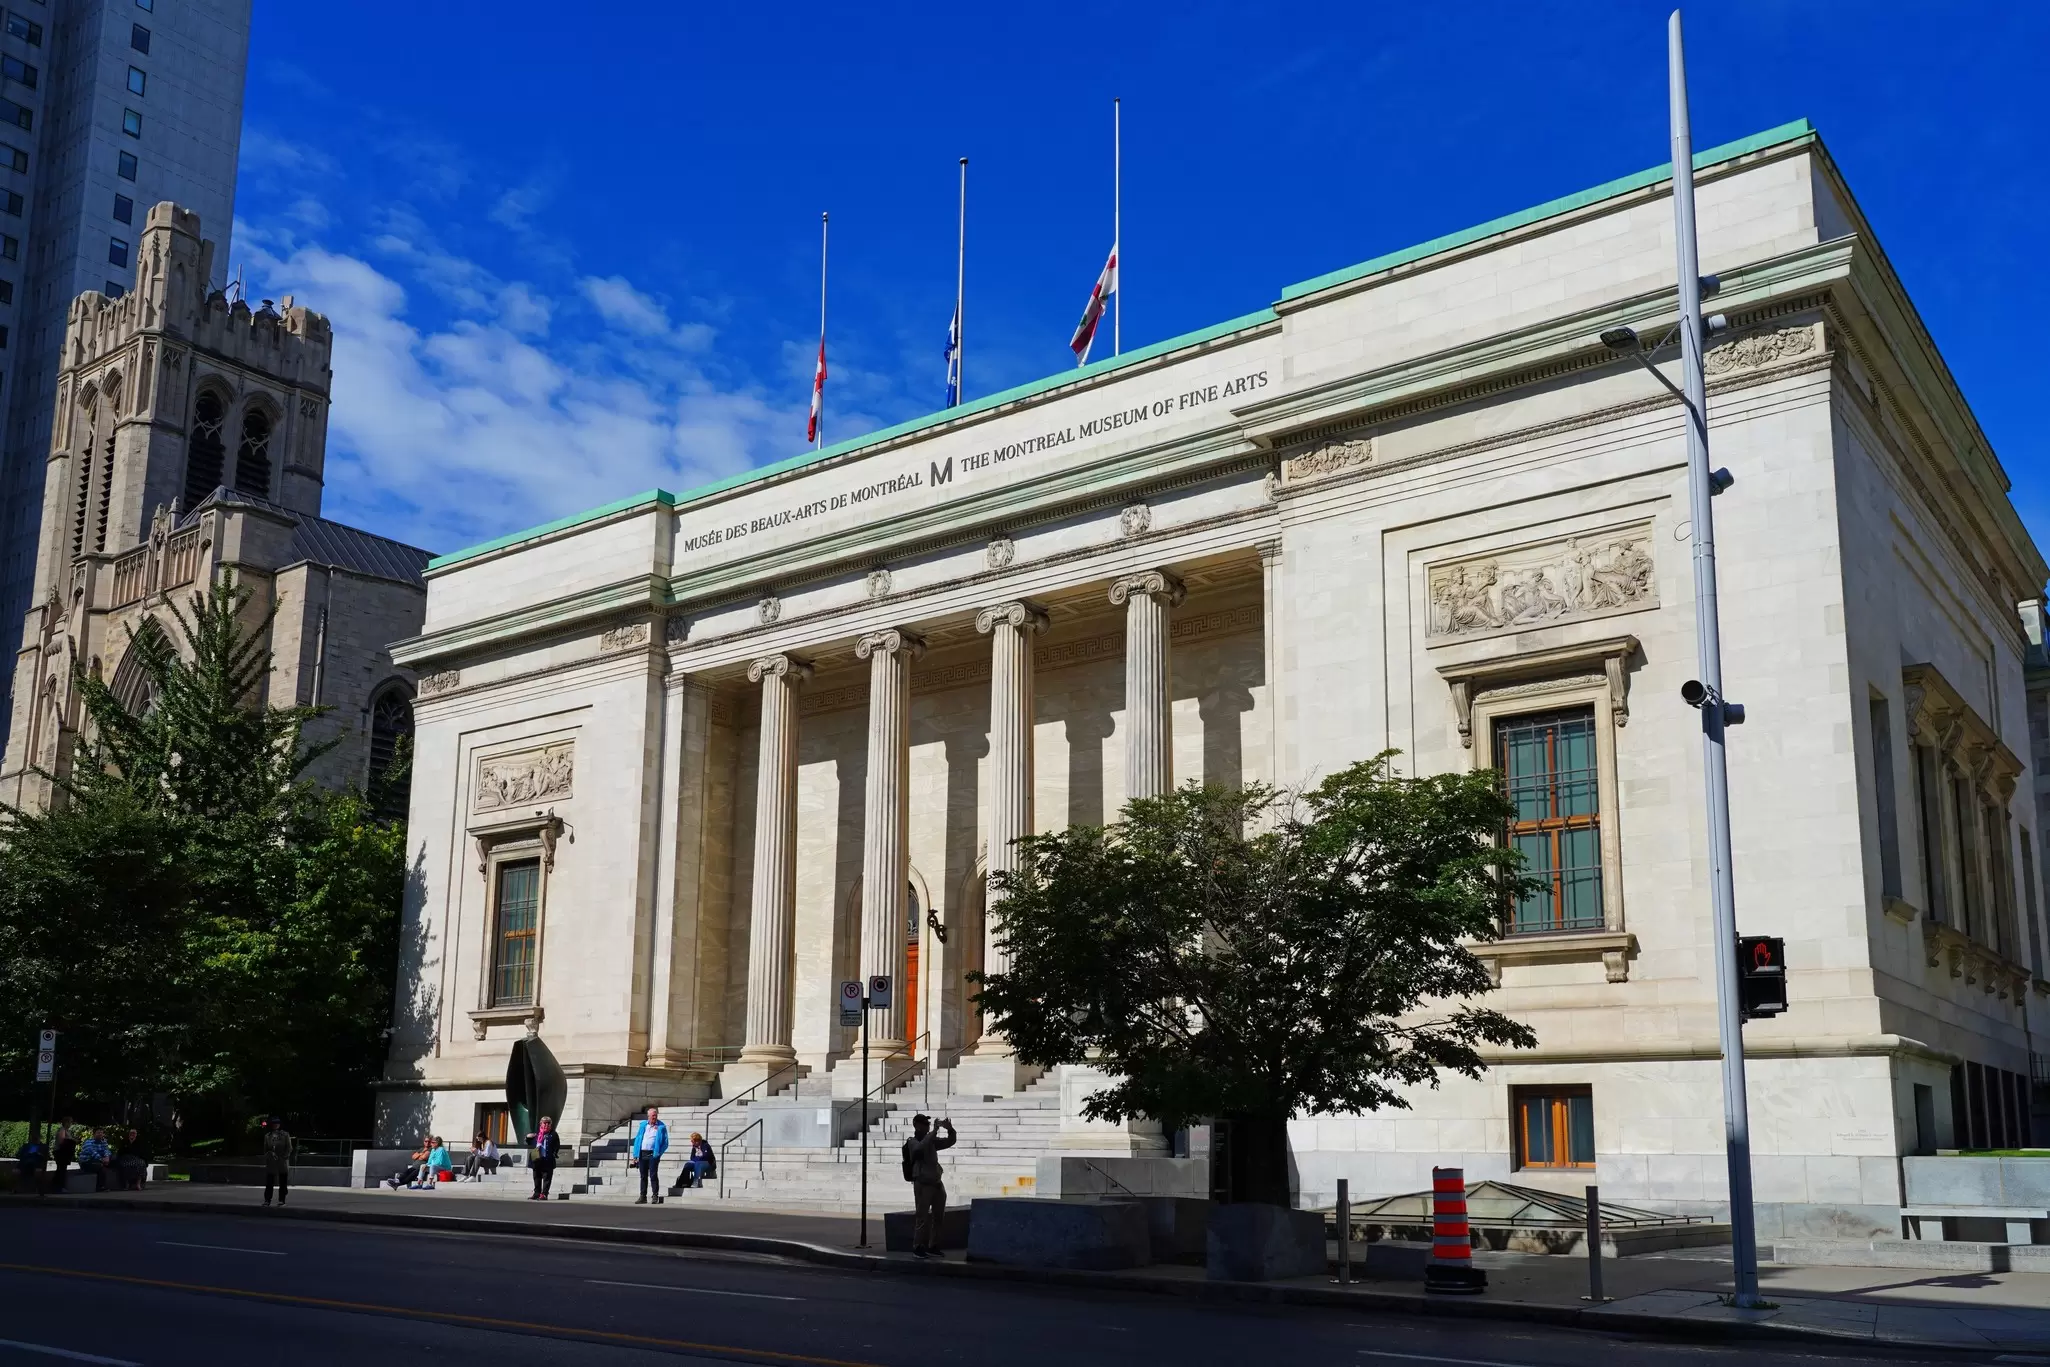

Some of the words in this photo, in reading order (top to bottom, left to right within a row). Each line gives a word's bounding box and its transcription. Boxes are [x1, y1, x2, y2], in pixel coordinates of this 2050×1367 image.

[684, 530, 722, 552] MUSÉE
[726, 523, 747, 541] DES
[751, 500, 827, 533] BEAUX-ARTS
[831, 494, 847, 511] DE
[851, 473, 923, 504] MONTRÉAL
[931, 457, 953, 488] M
[961, 452, 989, 472] THE
[994, 428, 1075, 464] MONTREAL
[1080, 406, 1148, 438] MUSEUM
[1153, 398, 1174, 416] OF
[1180, 386, 1217, 410] FINE
[1223, 371, 1267, 397] ARTS
